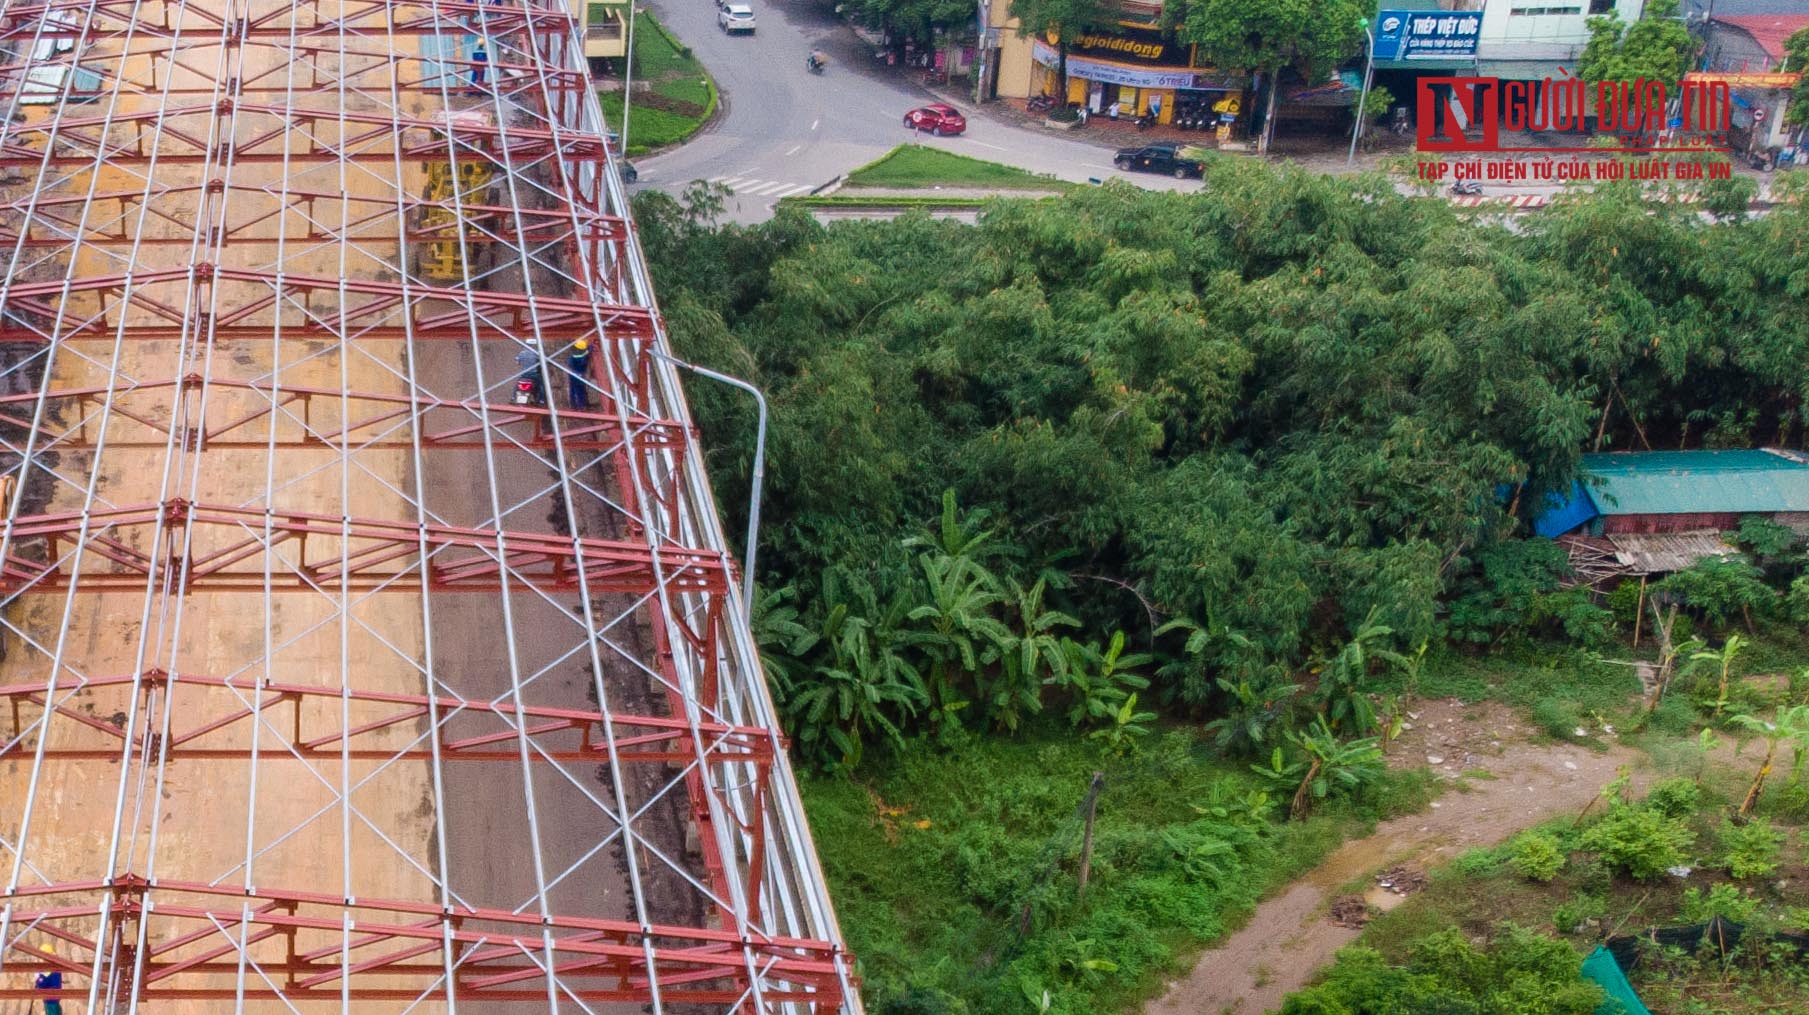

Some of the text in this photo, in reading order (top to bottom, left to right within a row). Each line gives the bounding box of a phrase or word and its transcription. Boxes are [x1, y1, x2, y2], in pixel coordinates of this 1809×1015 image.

[1413, 15, 1478, 37] THÉP VIỆT ĐỨC
